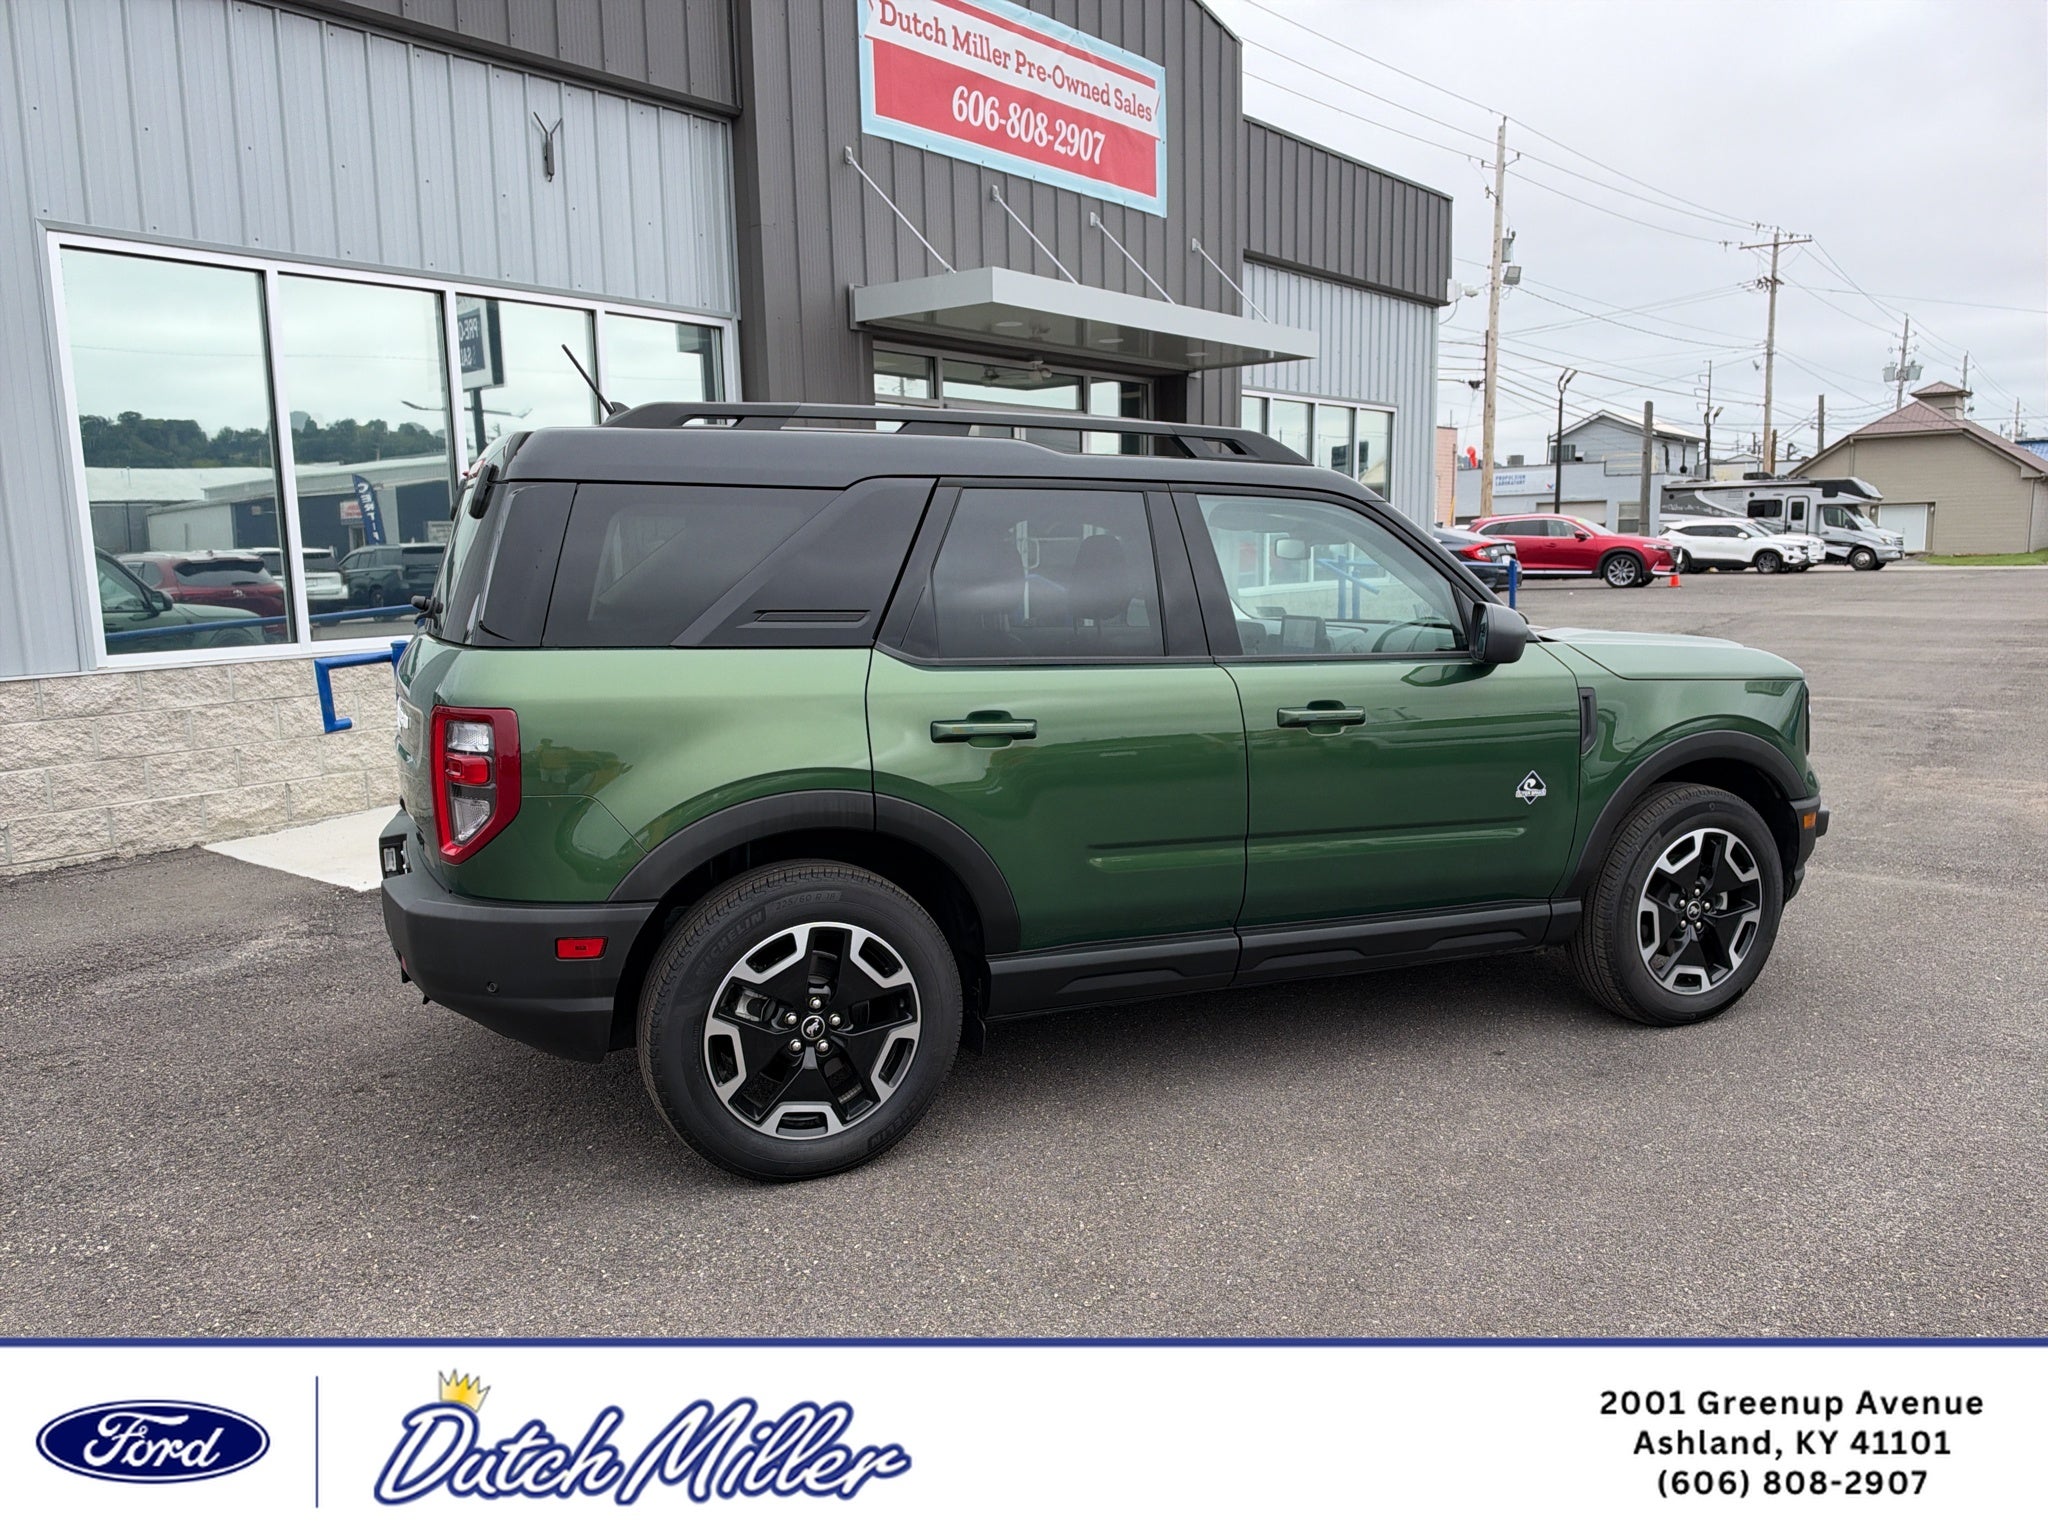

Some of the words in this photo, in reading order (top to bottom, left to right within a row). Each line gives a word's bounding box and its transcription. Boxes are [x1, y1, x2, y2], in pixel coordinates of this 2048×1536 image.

[880, 0, 947, 47] Dutch
[952, 25, 1011, 69] Miller
[1015, 49, 1110, 107] Pre-Owned
[1114, 88, 1152, 122] Sales
[952, 85, 1106, 165] 606-808-2907
